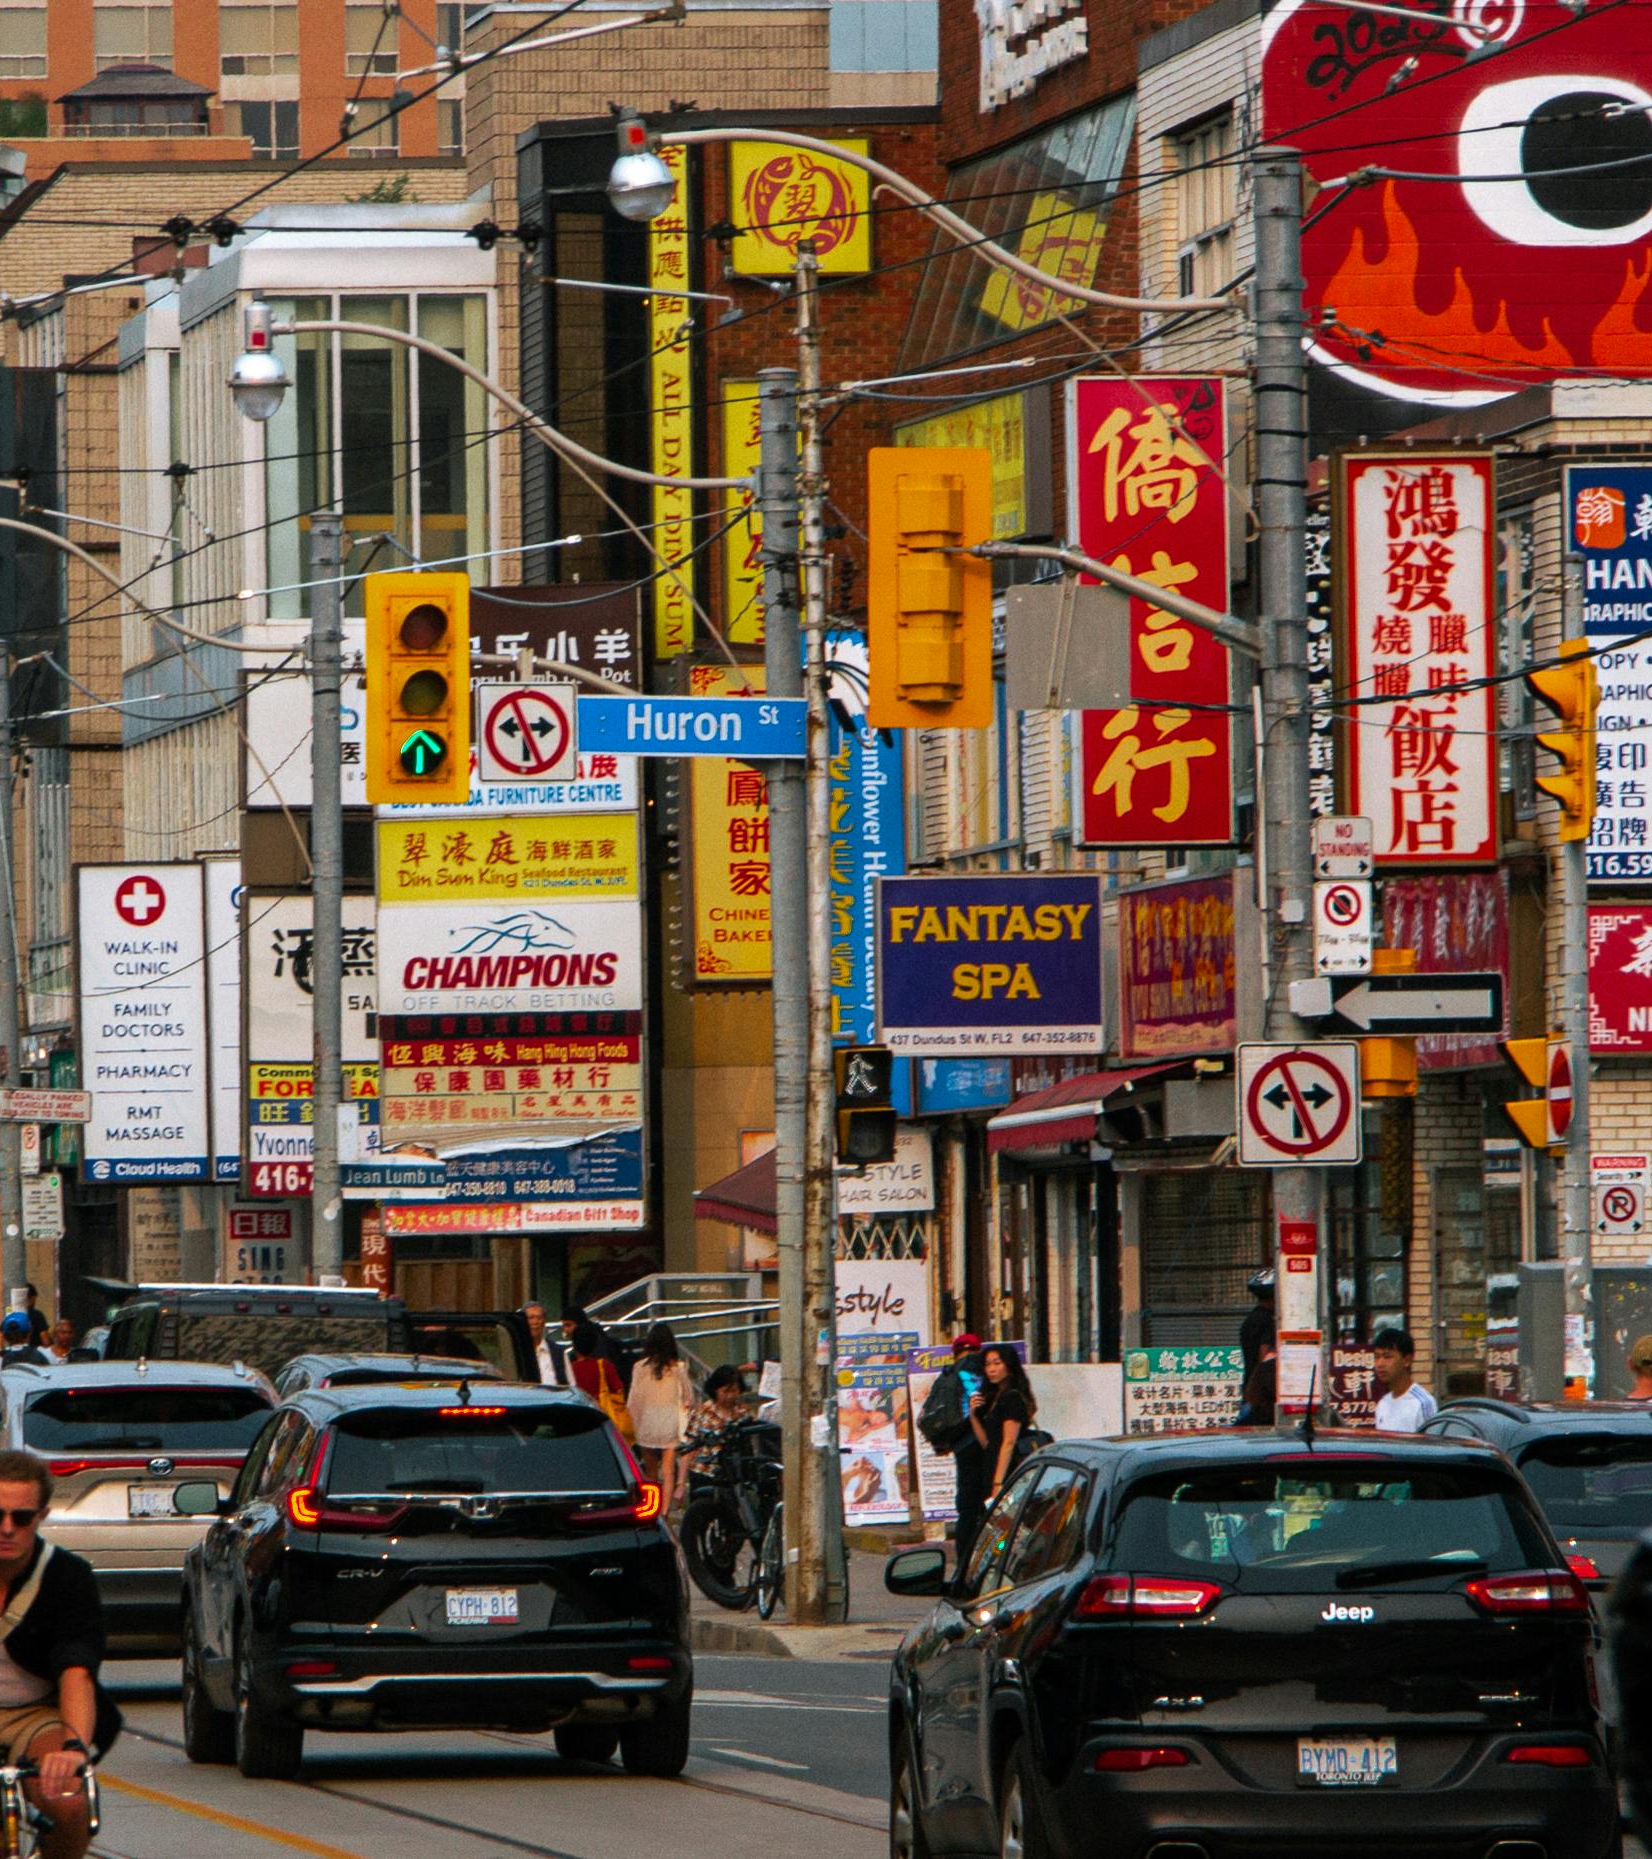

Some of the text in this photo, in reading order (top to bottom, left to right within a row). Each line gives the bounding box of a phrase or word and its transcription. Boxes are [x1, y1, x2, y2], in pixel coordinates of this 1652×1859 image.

[665, 582, 685, 647] SUM
[600, 667, 632, 683] Pot
[626, 703, 780, 742] Huron St
[488, 787, 564, 804] FURNITURE
[569, 784, 622, 801] CENTRE
[1335, 824, 1353, 838] NO
[1320, 843, 1369, 856] STANDING
[398, 867, 519, 889] Dim Sum King
[709, 908, 769, 922] CHINE
[890, 904, 1092, 943] FANTASY
[105, 942, 178, 955] WALK-IN
[114, 962, 171, 975] CLINIC
[404, 953, 618, 989] CHAMPIONS
[952, 963, 1041, 1000] SPA
[403, 992, 614, 1010] OFF TRACK BETTING
[114, 1004, 171, 1016] FAMILY
[103, 1024, 184, 1037] DOCTORS
[890, 1035, 909, 1045] 437
[912, 1035, 956, 1045] Dundas
[992, 1033, 1013, 1044] FL2
[97, 1064, 191, 1078] PHARMACY
[127, 1106, 162, 1119] RMT
[106, 1126, 184, 1140] MASSAGE
[116, 1162, 200, 1176] Cloud Health
[347, 1168, 444, 1184] Jean Lumb Ln
[878, 1187, 927, 1200] SALON
[526, 1208, 583, 1223] Canadian
[610, 1205, 640, 1222] Shop
[337, 1569, 385, 1579] CR-V
[1321, 1602, 1374, 1622] Jeep
